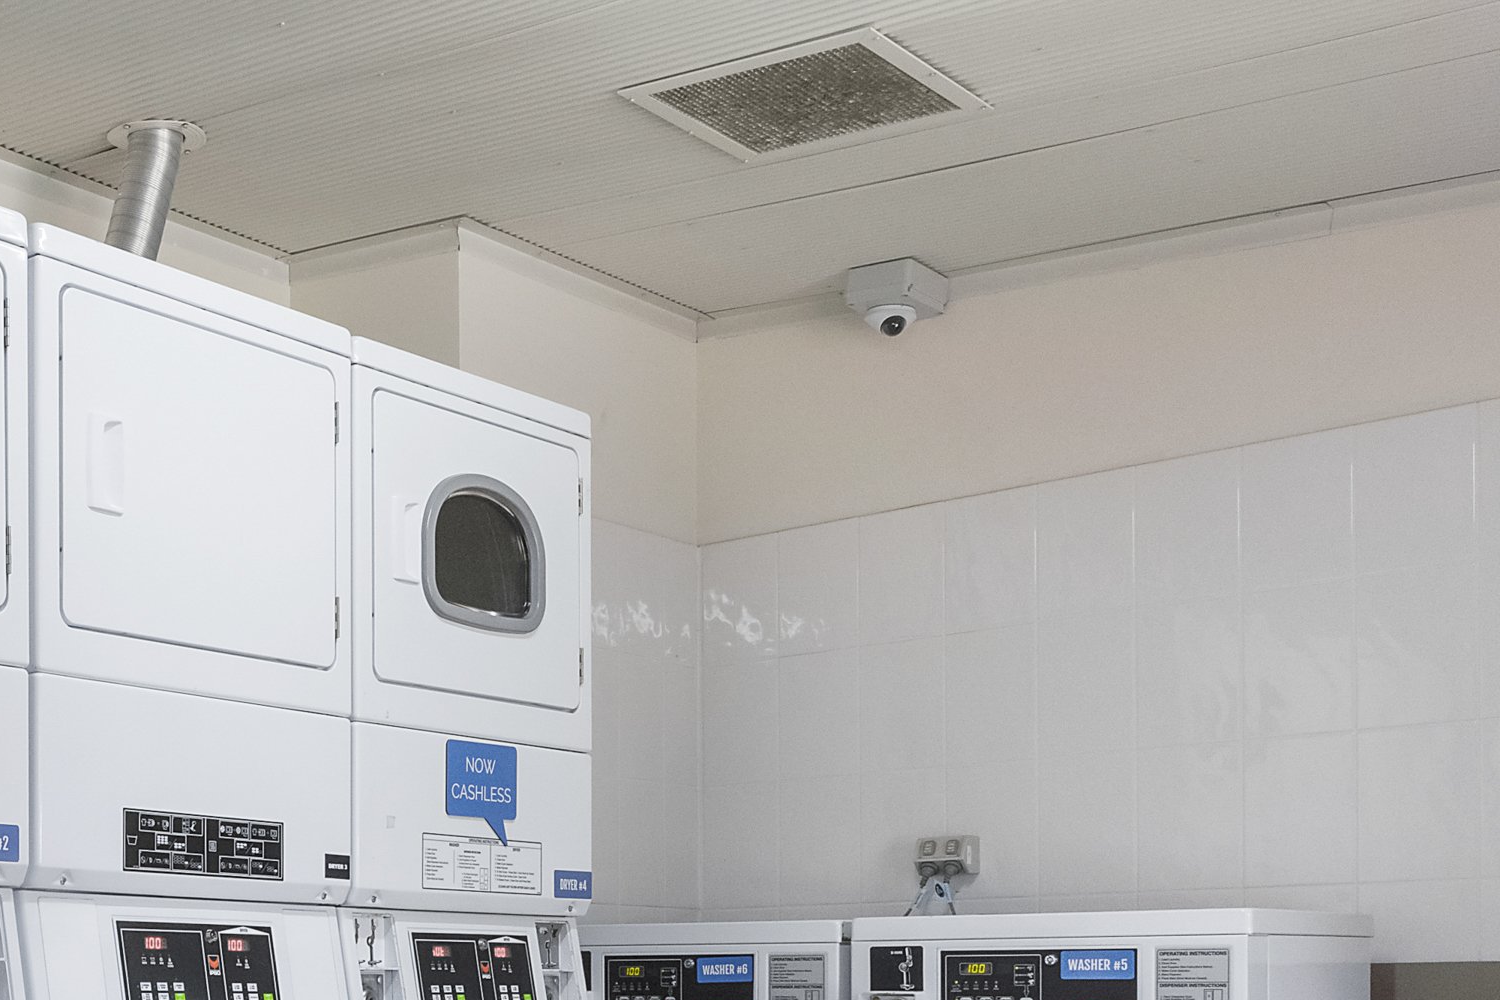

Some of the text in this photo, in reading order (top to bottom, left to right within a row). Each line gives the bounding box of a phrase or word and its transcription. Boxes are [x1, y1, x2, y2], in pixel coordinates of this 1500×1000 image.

[466, 756, 496, 774] NOW
[452, 783, 512, 804] CASHLESS
[560, 879, 587, 891] DRYER #4
[145, 937, 162, 949] 100
[228, 939, 242, 951] 100
[494, 947, 505, 958] 100
[702, 964, 748, 975] WASHER #6
[968, 964, 986, 974] 100
[1068, 958, 1128, 971] WASHER #5
[626, 967, 640, 976] 100
